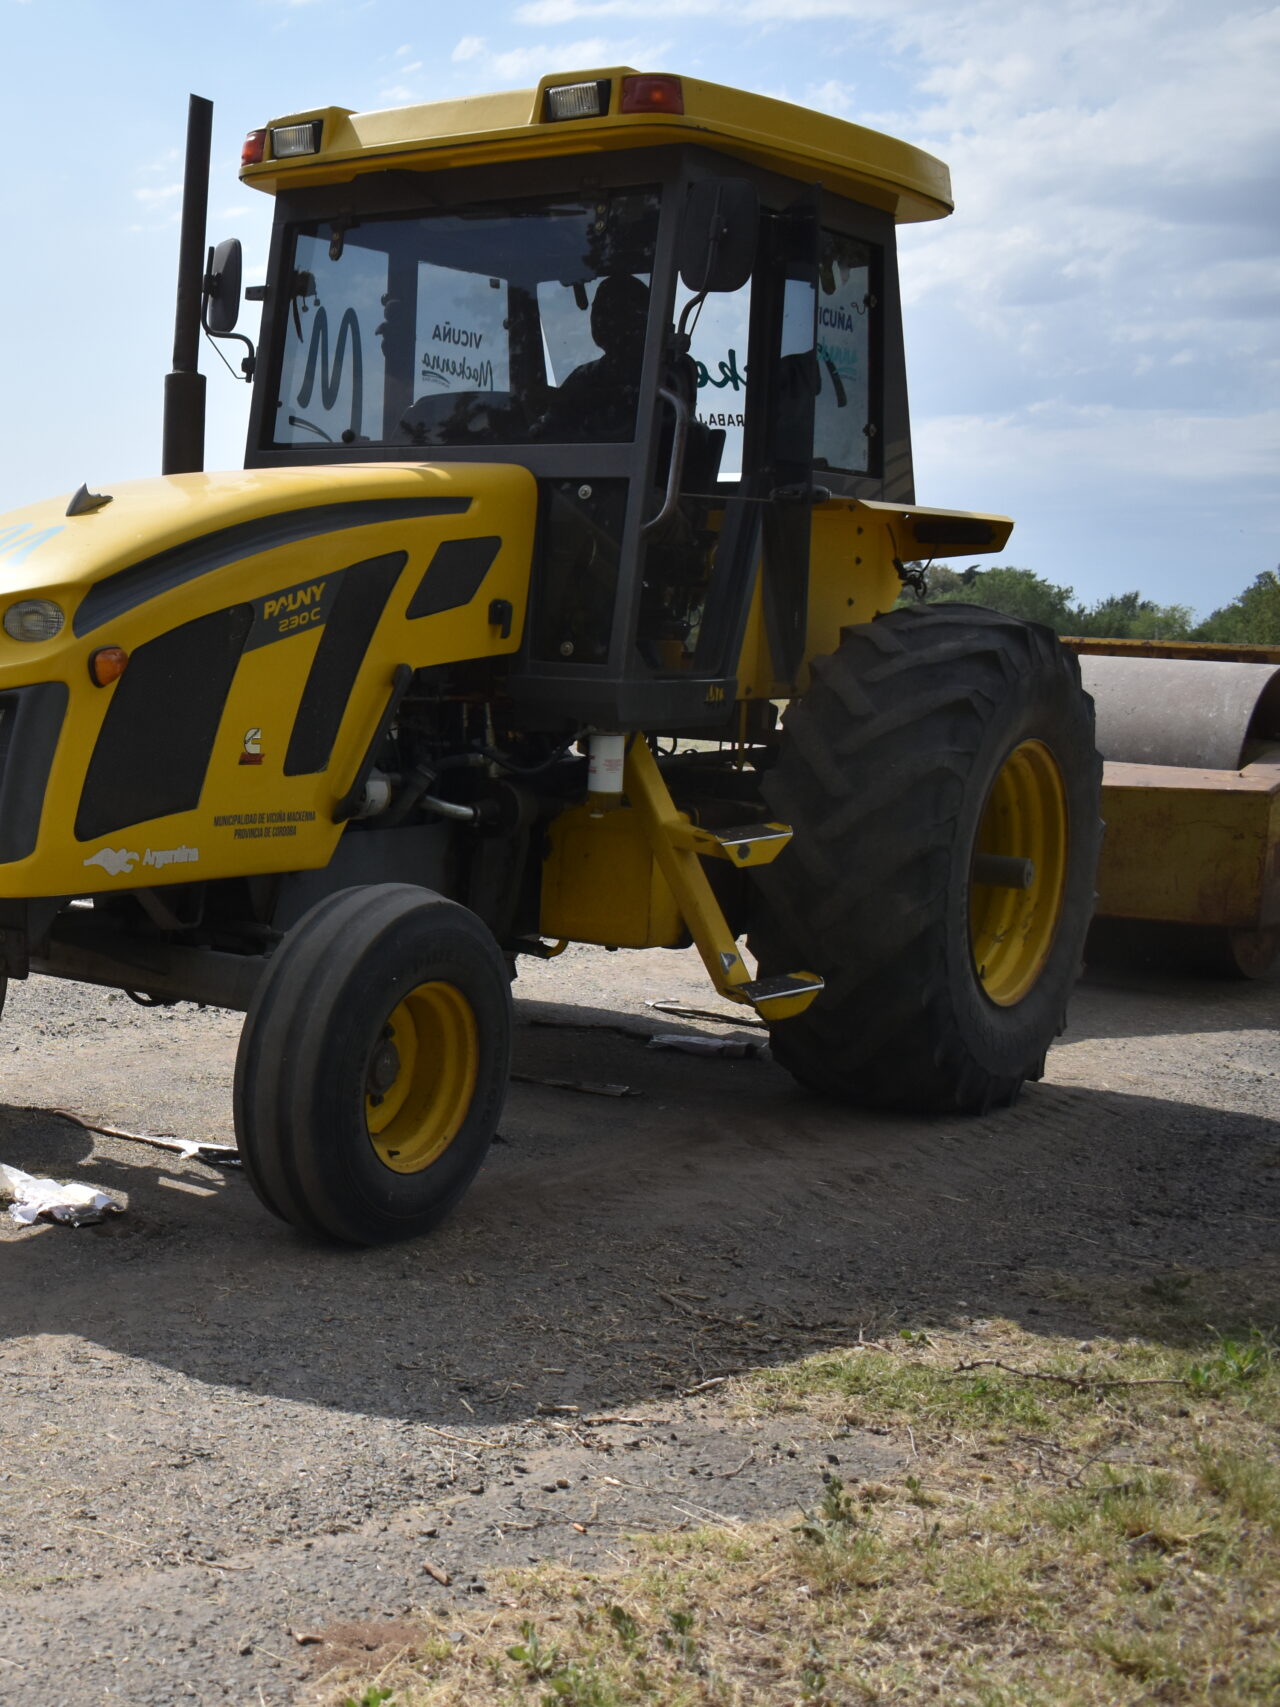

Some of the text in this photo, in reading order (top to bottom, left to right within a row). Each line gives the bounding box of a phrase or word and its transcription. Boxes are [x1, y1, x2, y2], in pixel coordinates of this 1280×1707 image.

[818, 306, 854, 333] ICUÑA
[264, 582, 326, 620] PAUNY
[214, 813, 257, 826] MUNICIPALIDAD
[258, 813, 265, 824] DE
[267, 810, 286, 823] VICUÑA
[234, 827, 263, 839] PROVINCIA
[264, 826, 271, 838] DE
[142, 844, 199, 869] Argentina
